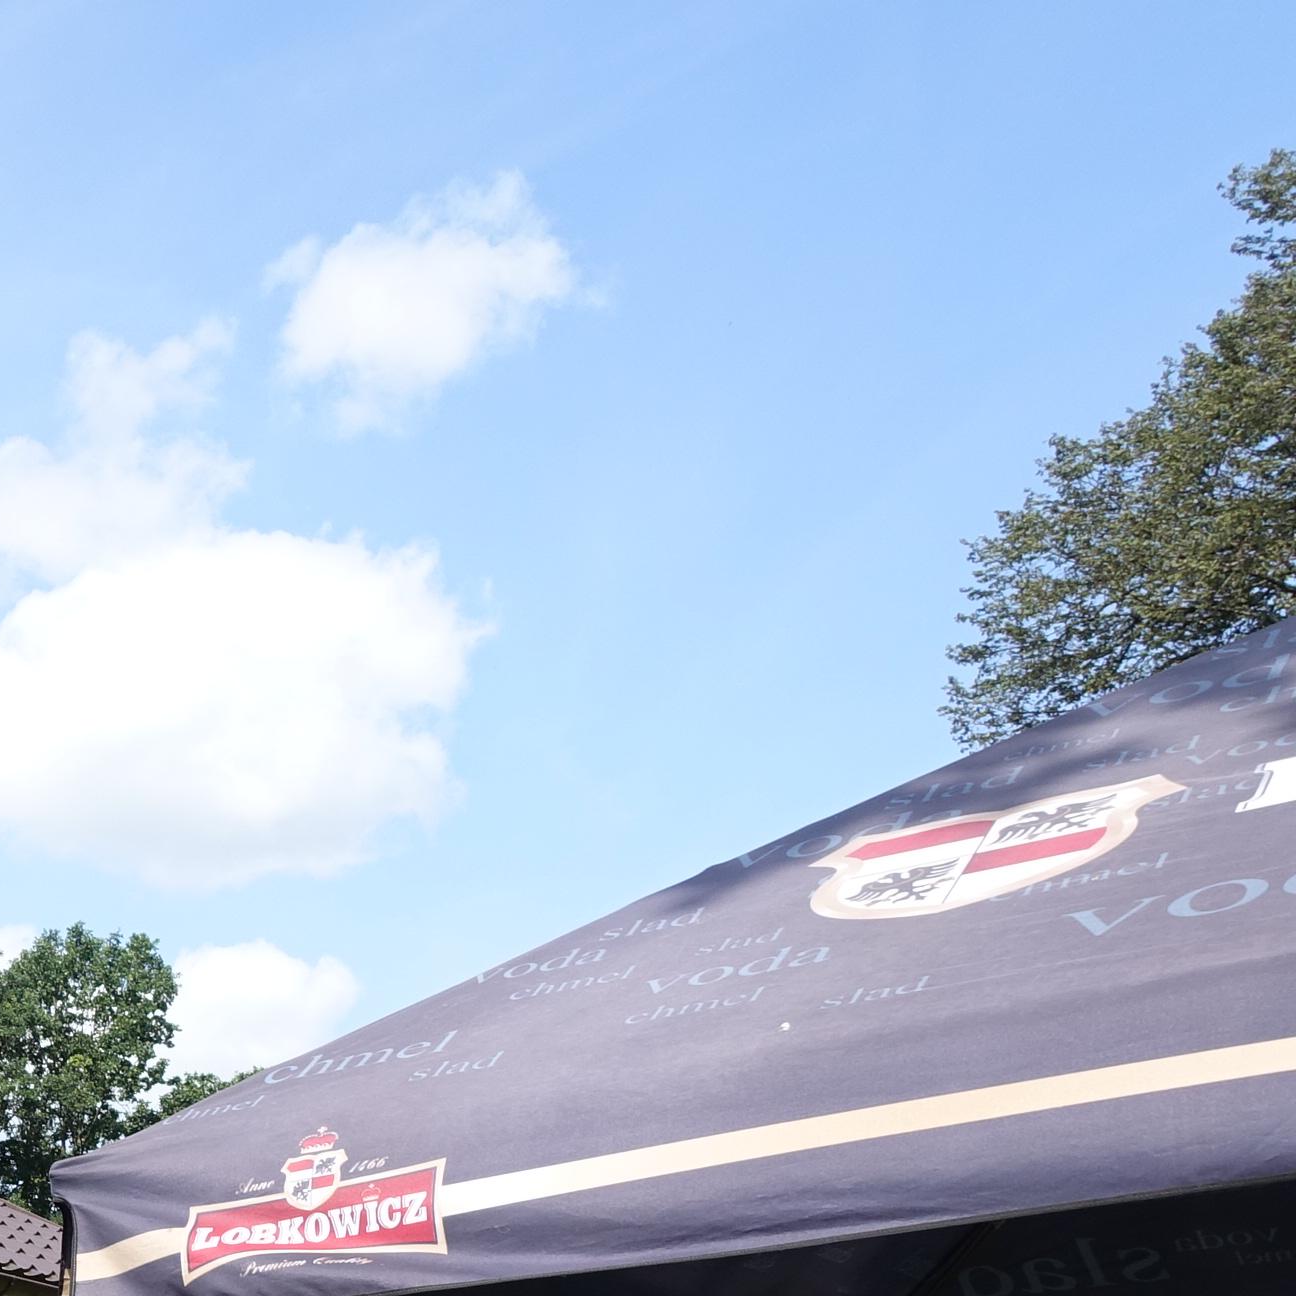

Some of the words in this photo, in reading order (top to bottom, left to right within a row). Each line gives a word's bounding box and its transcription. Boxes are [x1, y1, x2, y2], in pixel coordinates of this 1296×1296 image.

[884, 766, 1025, 810] slad
[598, 907, 705, 942] slad
[694, 927, 784, 957] slad
[474, 948, 608, 984] voda
[509, 965, 637, 1001] chmel
[648, 946, 830, 995] voda
[625, 986, 768, 1024] chmel
[820, 975, 932, 1010] slad
[264, 1030, 458, 1085] chmel
[408, 1050, 505, 1082] slad
[163, 1094, 265, 1126] chmel
[236, 1178, 275, 1195] Anno
[192, 1191, 427, 1251] LOBKOWICZ
[240, 1259, 306, 1277] Premium
